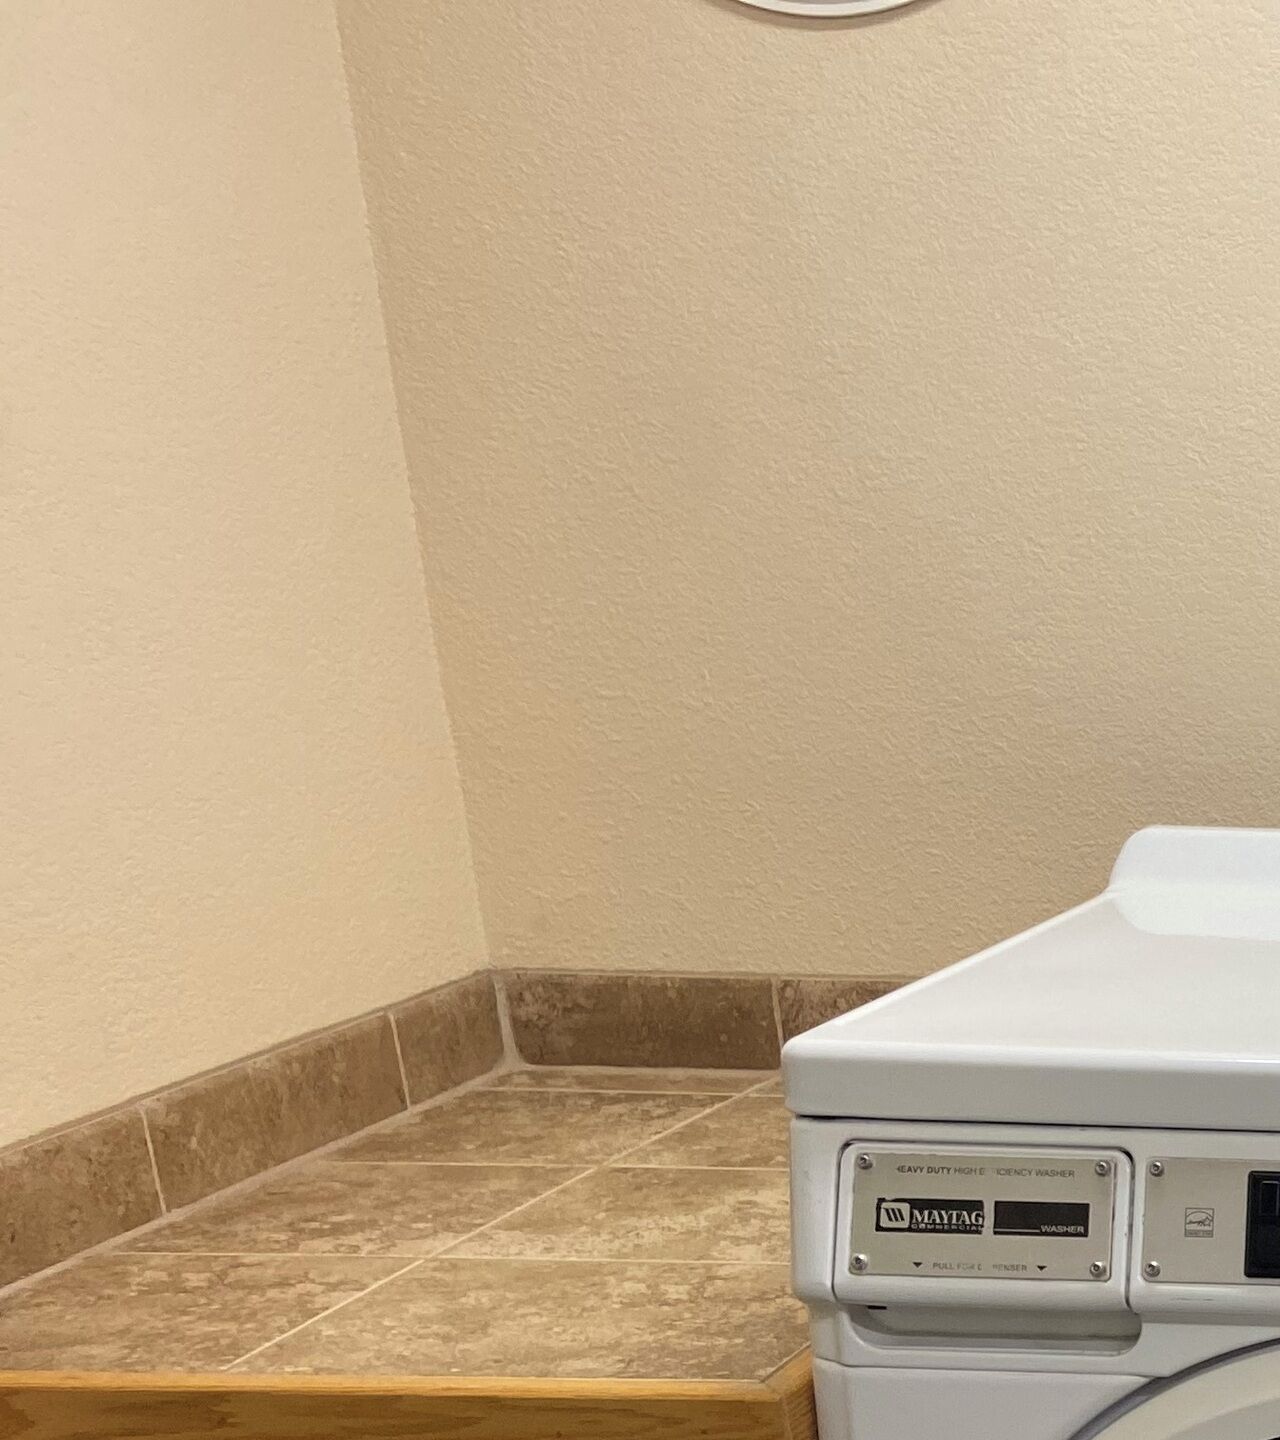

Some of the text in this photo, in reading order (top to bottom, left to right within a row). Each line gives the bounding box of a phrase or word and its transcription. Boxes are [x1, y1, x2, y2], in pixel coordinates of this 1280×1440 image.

[926, 1166, 952, 1175] DUTY
[1035, 1168, 1076, 1178] WASHER
[912, 1209, 984, 1225] MAYTAG
[1040, 1224, 1085, 1234] WASHER
